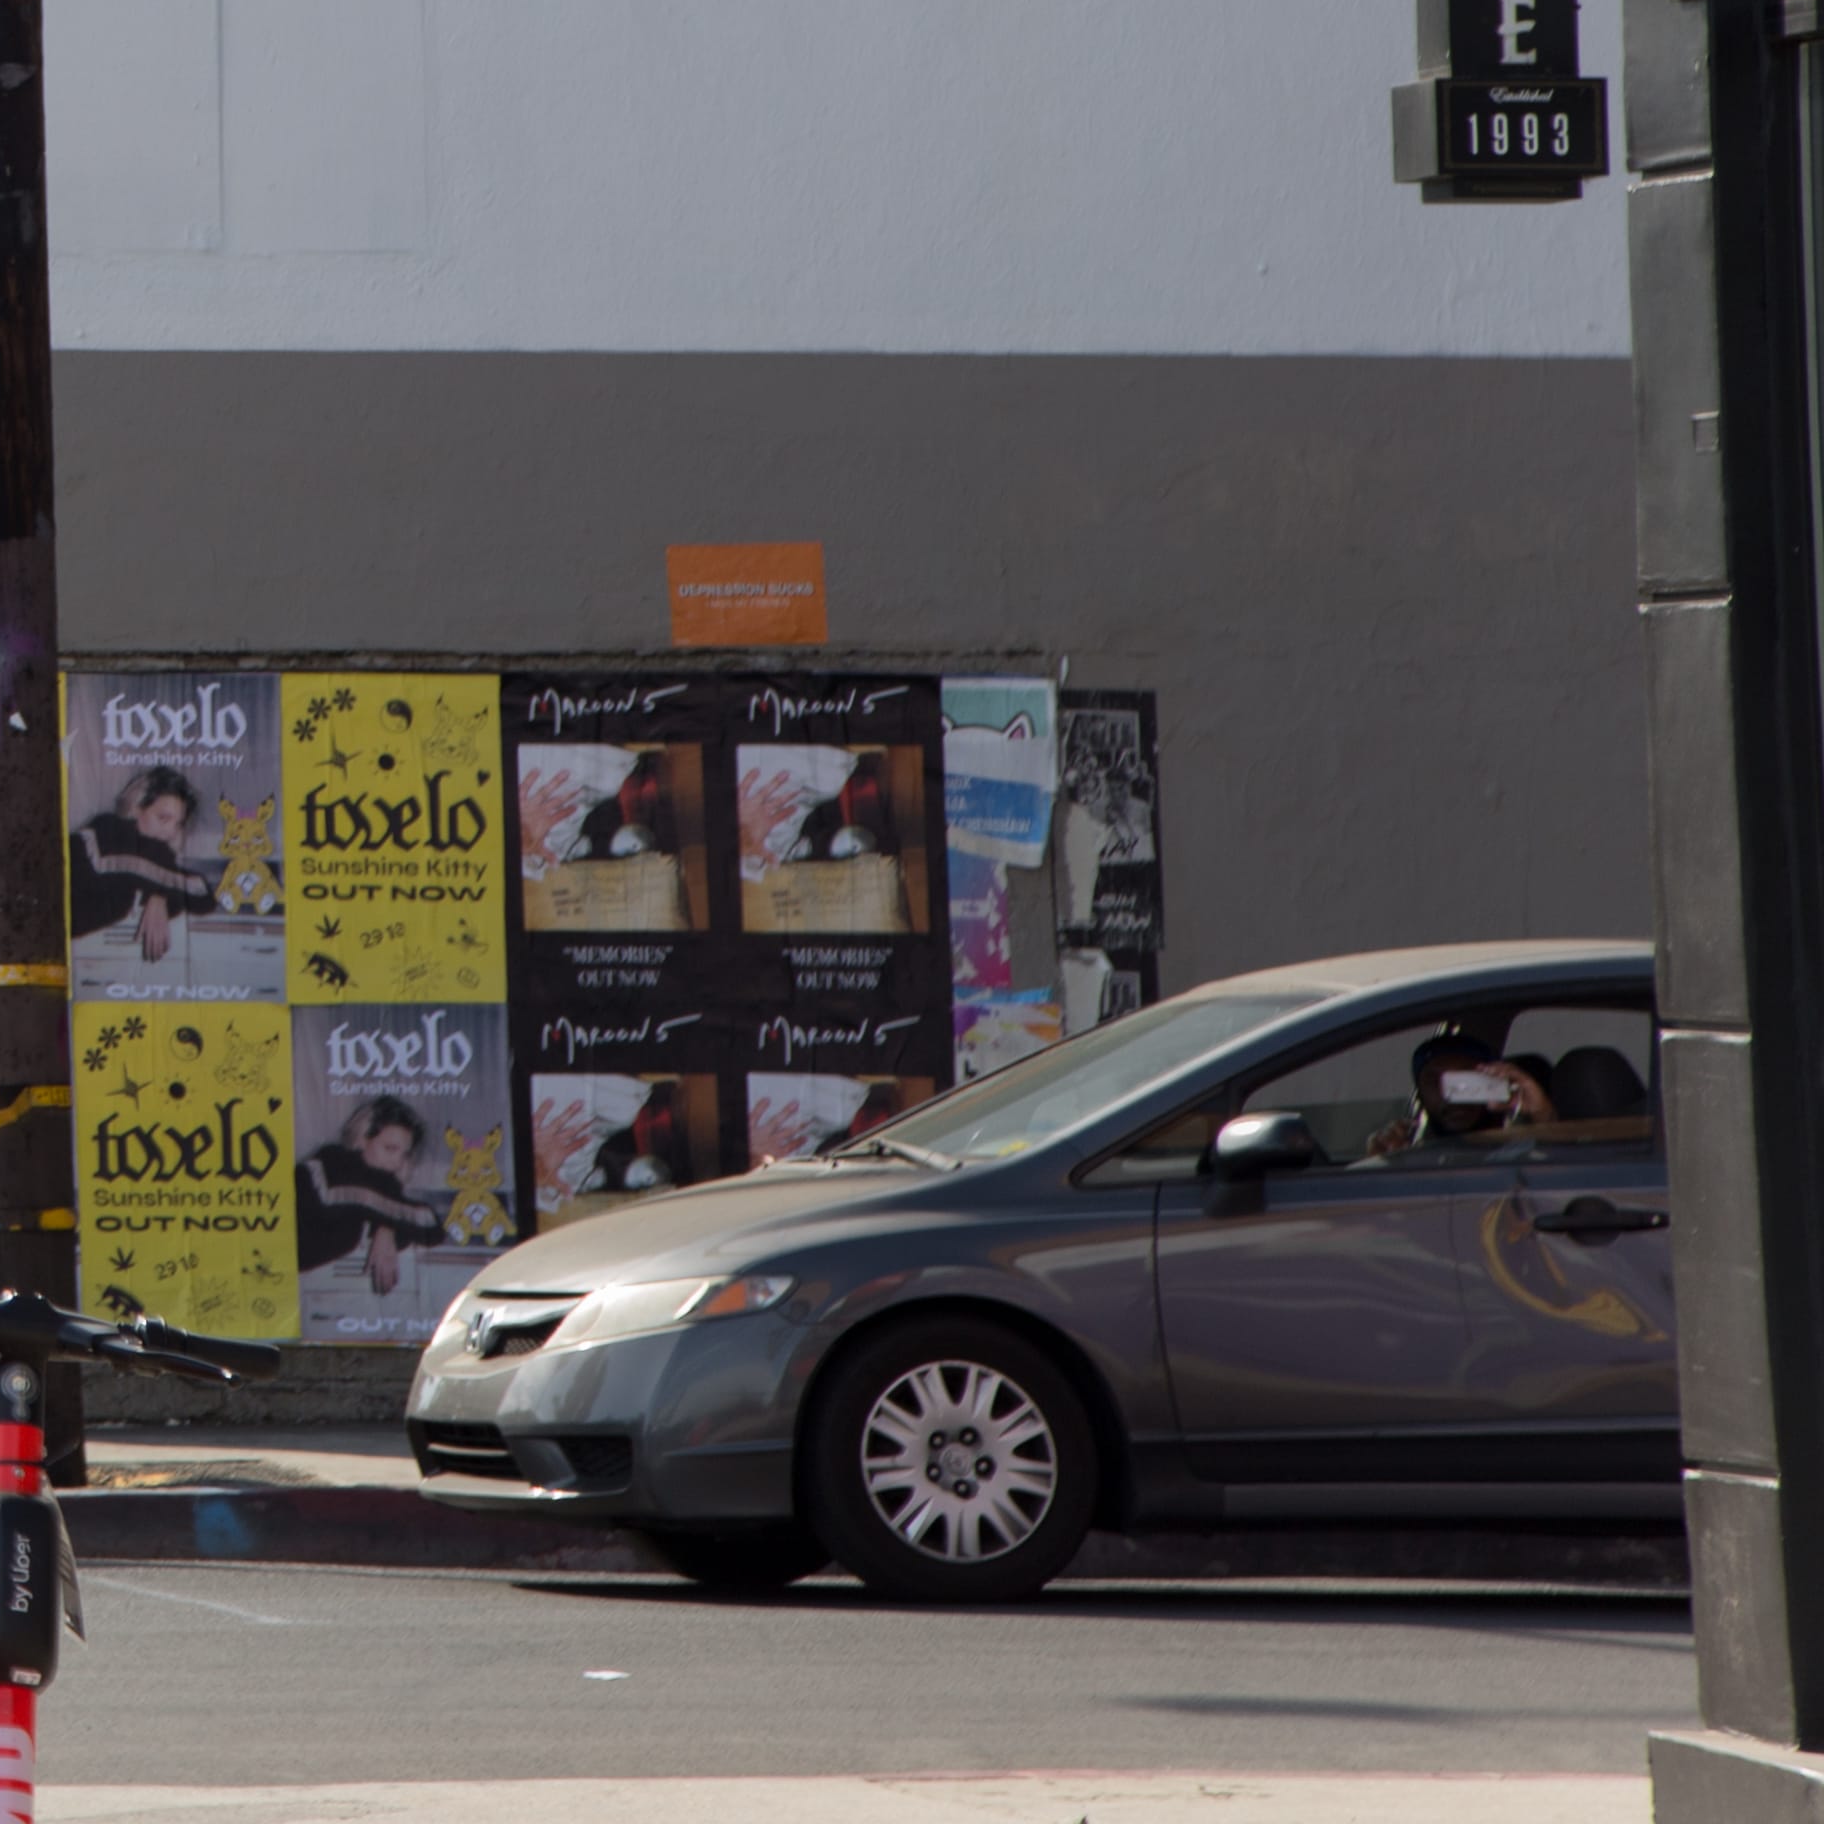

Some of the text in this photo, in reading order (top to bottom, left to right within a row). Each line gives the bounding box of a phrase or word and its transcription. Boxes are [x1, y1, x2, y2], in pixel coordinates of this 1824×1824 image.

[1489, 87, 1554, 104] Established
[1468, 112, 1570, 156] 1993
[105, 750, 244, 769] Sunshine Kitty
[300, 858, 488, 882] Sunshine Kitty
[302, 884, 487, 902] OUT NOW
[578, 970, 661, 988] OUT NOW
[796, 971, 881, 989] OUT NOW
[106, 984, 252, 1000] OUT NOW
[329, 1079, 471, 1099] Sunshine Kitty
[94, 1188, 281, 1211] Sunshine Kitty
[95, 1216, 281, 1232] OUT NOW
[337, 1317, 402, 1333] OUT
[11, 1586, 34, 1614] by
